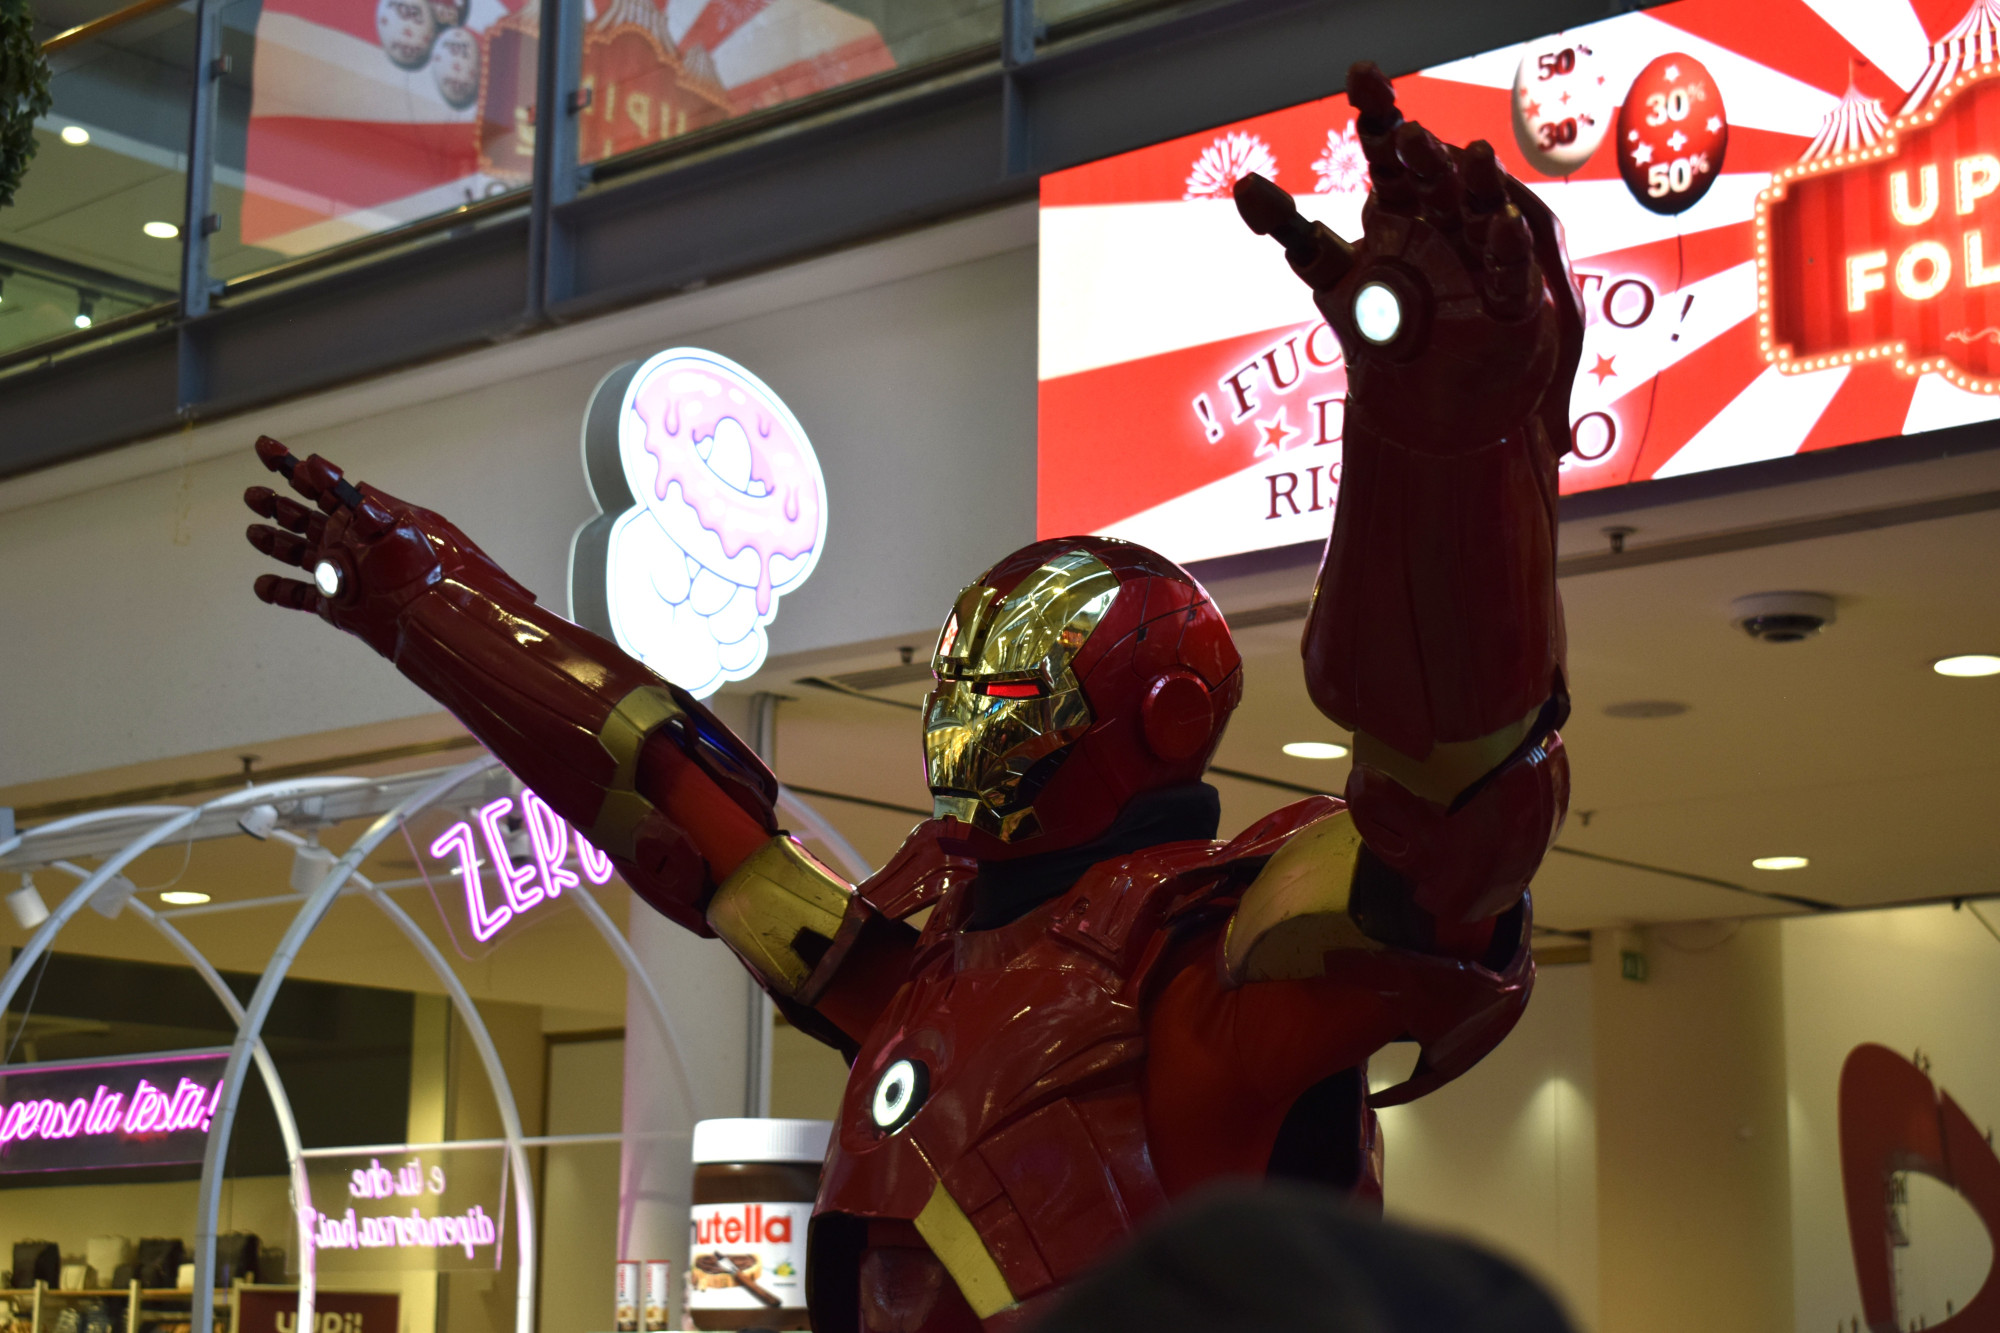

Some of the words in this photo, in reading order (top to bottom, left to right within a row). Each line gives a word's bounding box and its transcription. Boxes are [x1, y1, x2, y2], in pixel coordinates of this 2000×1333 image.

[1537, 44, 1593, 81] 50%
[1645, 82, 1706, 127] 30%
[1537, 113, 1595, 151] 30%
[1648, 152, 1710, 198] 50%
[84, 1085, 124, 1135] la
